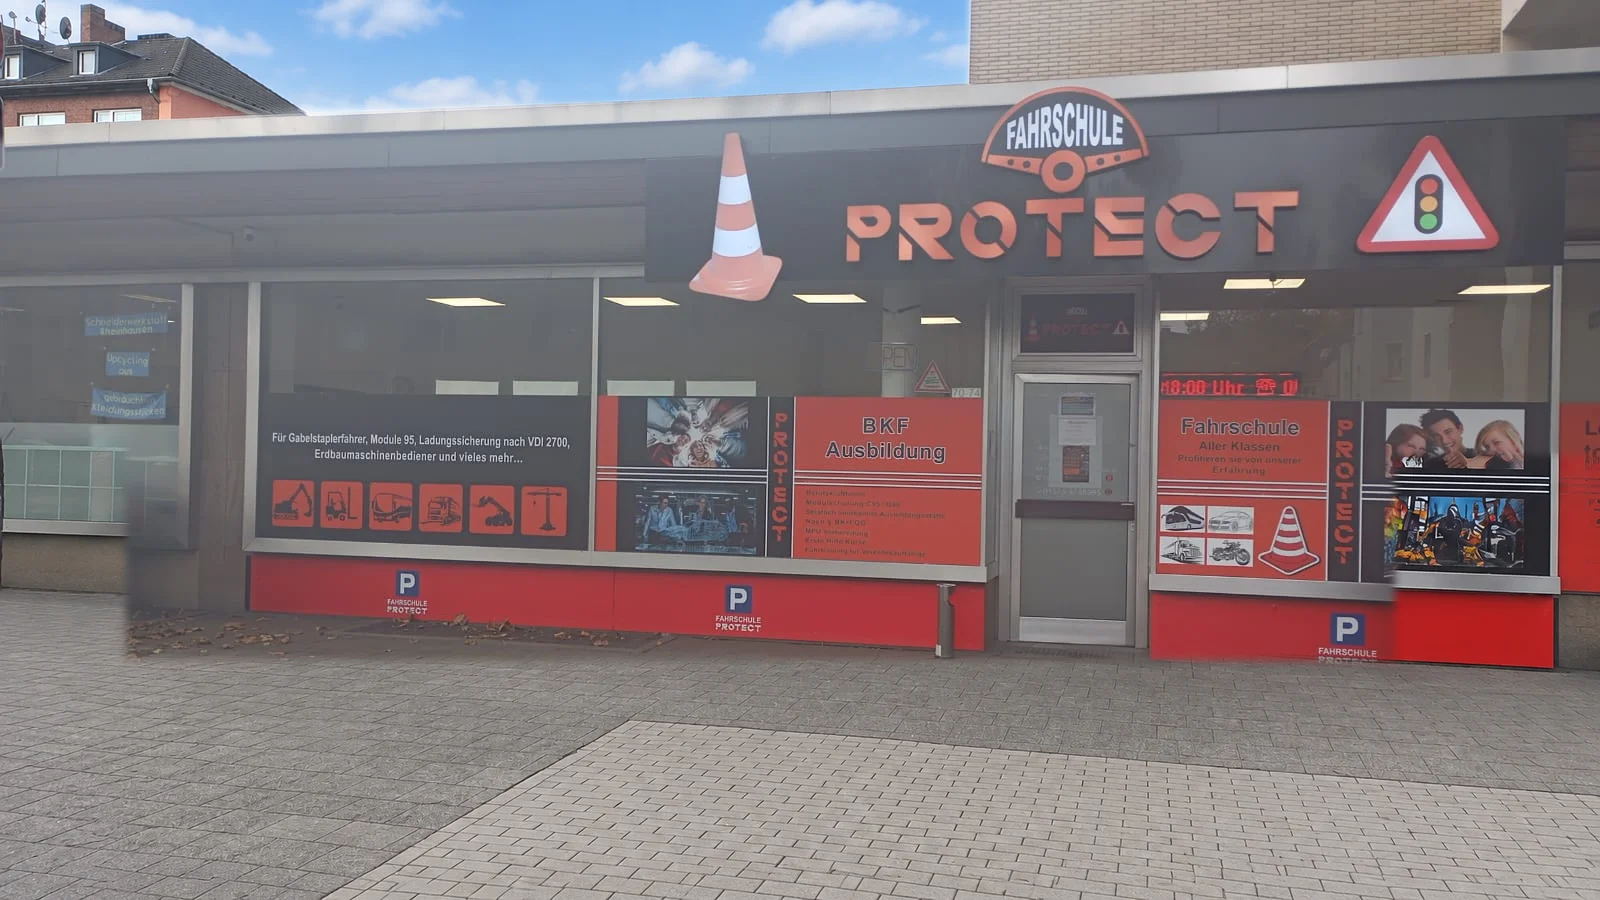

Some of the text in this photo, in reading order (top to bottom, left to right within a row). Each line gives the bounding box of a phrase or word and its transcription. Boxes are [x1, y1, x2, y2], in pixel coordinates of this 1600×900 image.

[1006, 102, 1124, 150] FAHRSCHULE
[845, 191, 1299, 263] PROTECT
[1212, 379, 1245, 396] Uhr
[862, 416, 911, 436] BKF
[1180, 416, 1301, 437] Fahrschule
[272, 432, 571, 450] Für Gabelstaplerfahrer, Module 95, Ladungssicherung nach VDI 2700,
[1199, 440, 1281, 453] Aller Klassen
[314, 448, 524, 464] Erdbaumaschinenbediener und vieles mehr...
[825, 440, 947, 465] Ausbildung
[1177, 454, 1227, 465] Profitieren
[1244, 455, 1263, 466] von
[770, 412, 789, 543] PROTECT
[1211, 465, 1267, 477] Erfahrung
[1333, 418, 1355, 566] PROTECT
[399, 572, 416, 595] P
[386, 598, 429, 608] FAHRSCHULE
[729, 587, 748, 611] P
[386, 605, 429, 616] PROTECT
[715, 614, 762, 625] FAHRSCHULE
[715, 623, 762, 633] PROTECT
[1336, 616, 1359, 642] P
[1318, 647, 1378, 658] FAHRSCHULE
